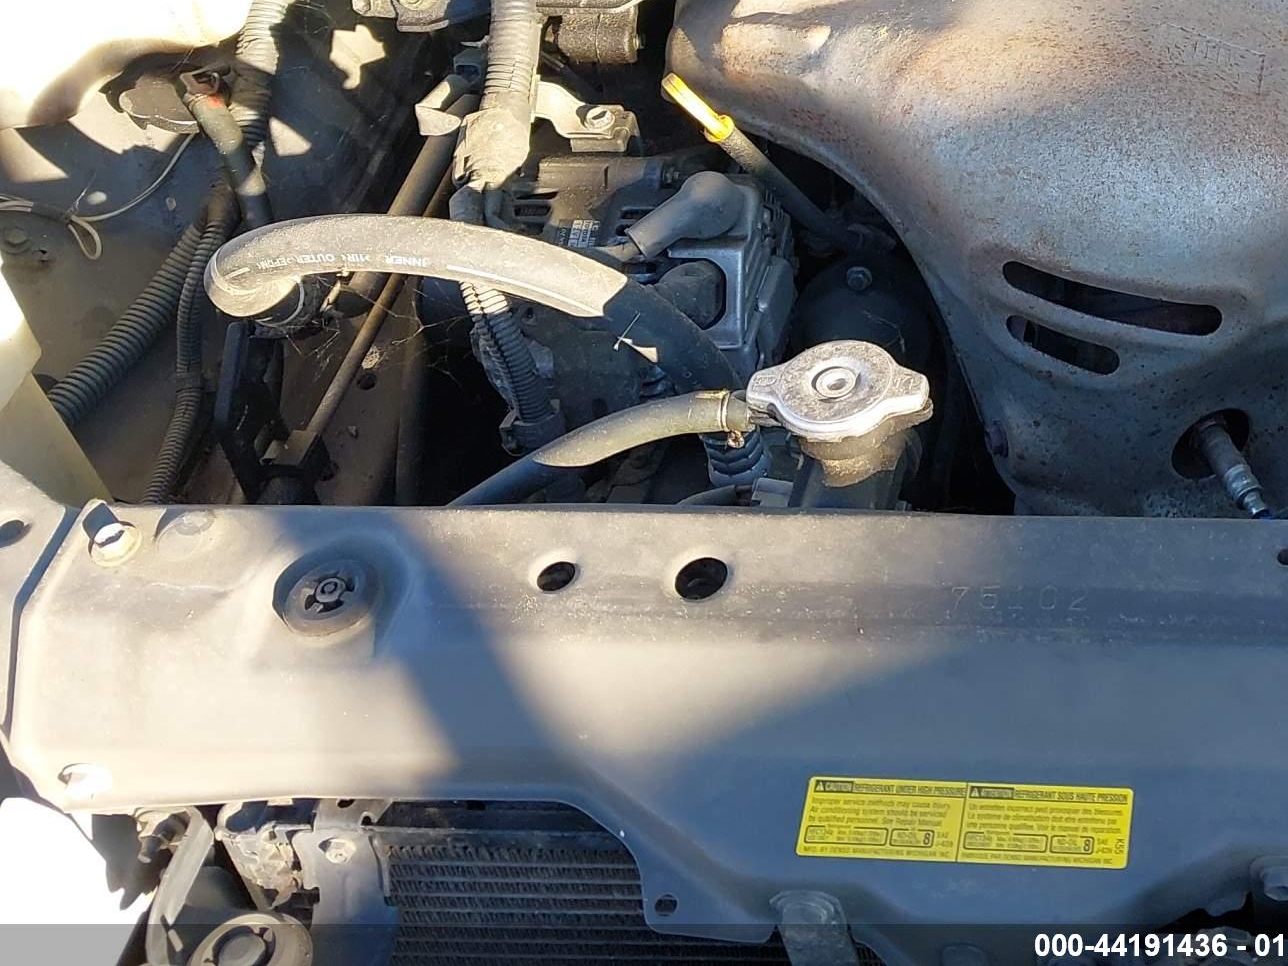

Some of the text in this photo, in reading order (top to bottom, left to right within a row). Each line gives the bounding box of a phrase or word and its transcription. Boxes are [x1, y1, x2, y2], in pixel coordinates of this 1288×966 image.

[296, 253, 335, 265] OUTER
[933, 786, 967, 796] PRESSURE
[1097, 793, 1128, 802] PRESSION
[922, 832, 932, 846] 8
[1083, 839, 1091, 852] 8
[1114, 838, 1125, 855] K55
